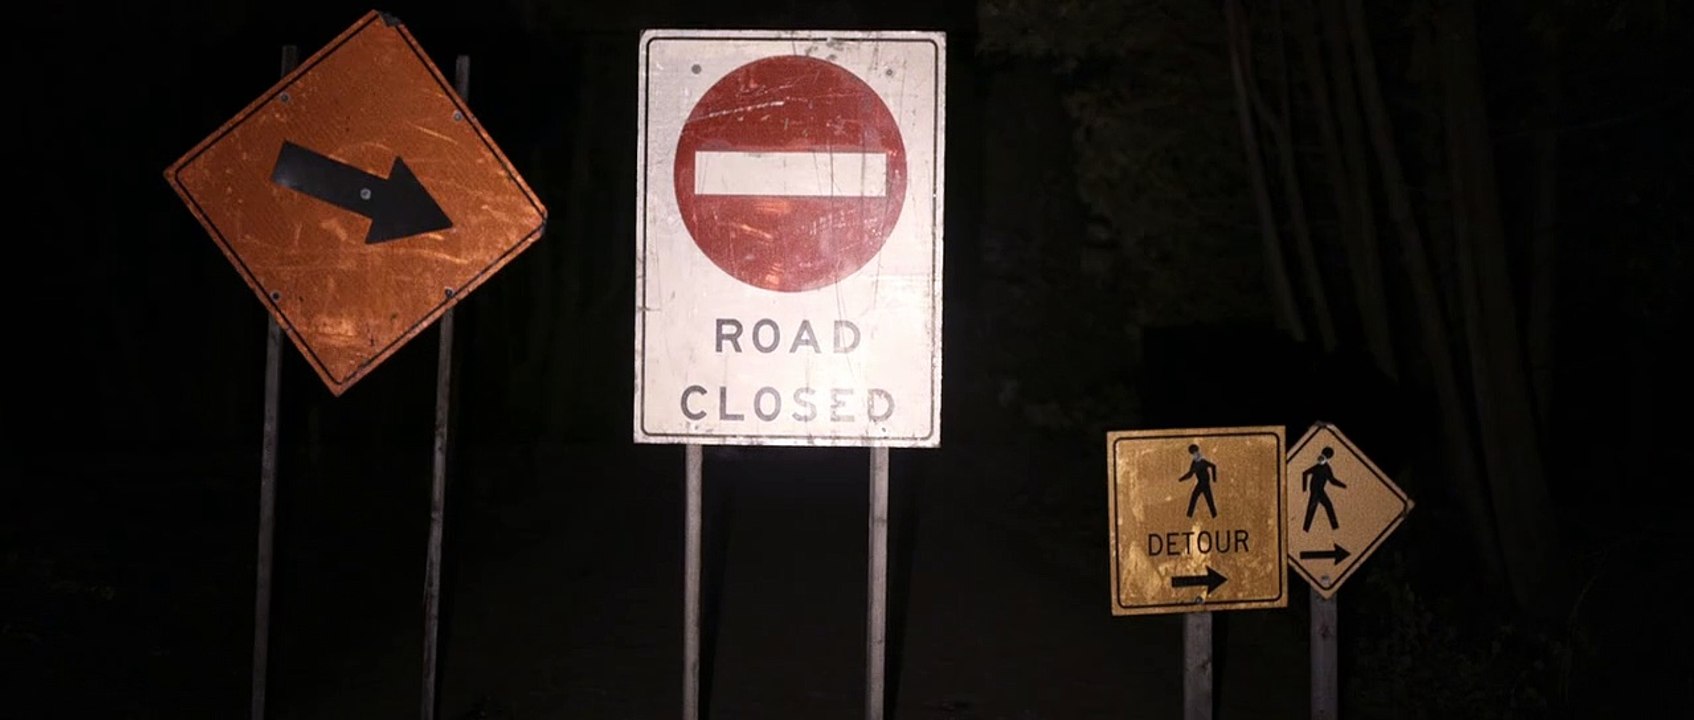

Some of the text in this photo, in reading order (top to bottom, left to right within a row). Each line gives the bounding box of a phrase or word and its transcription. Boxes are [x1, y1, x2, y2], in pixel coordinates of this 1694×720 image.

[715, 318, 861, 353] ROAD
[680, 385, 895, 422] CLOSED
[1147, 529, 1250, 556] DETOUR
